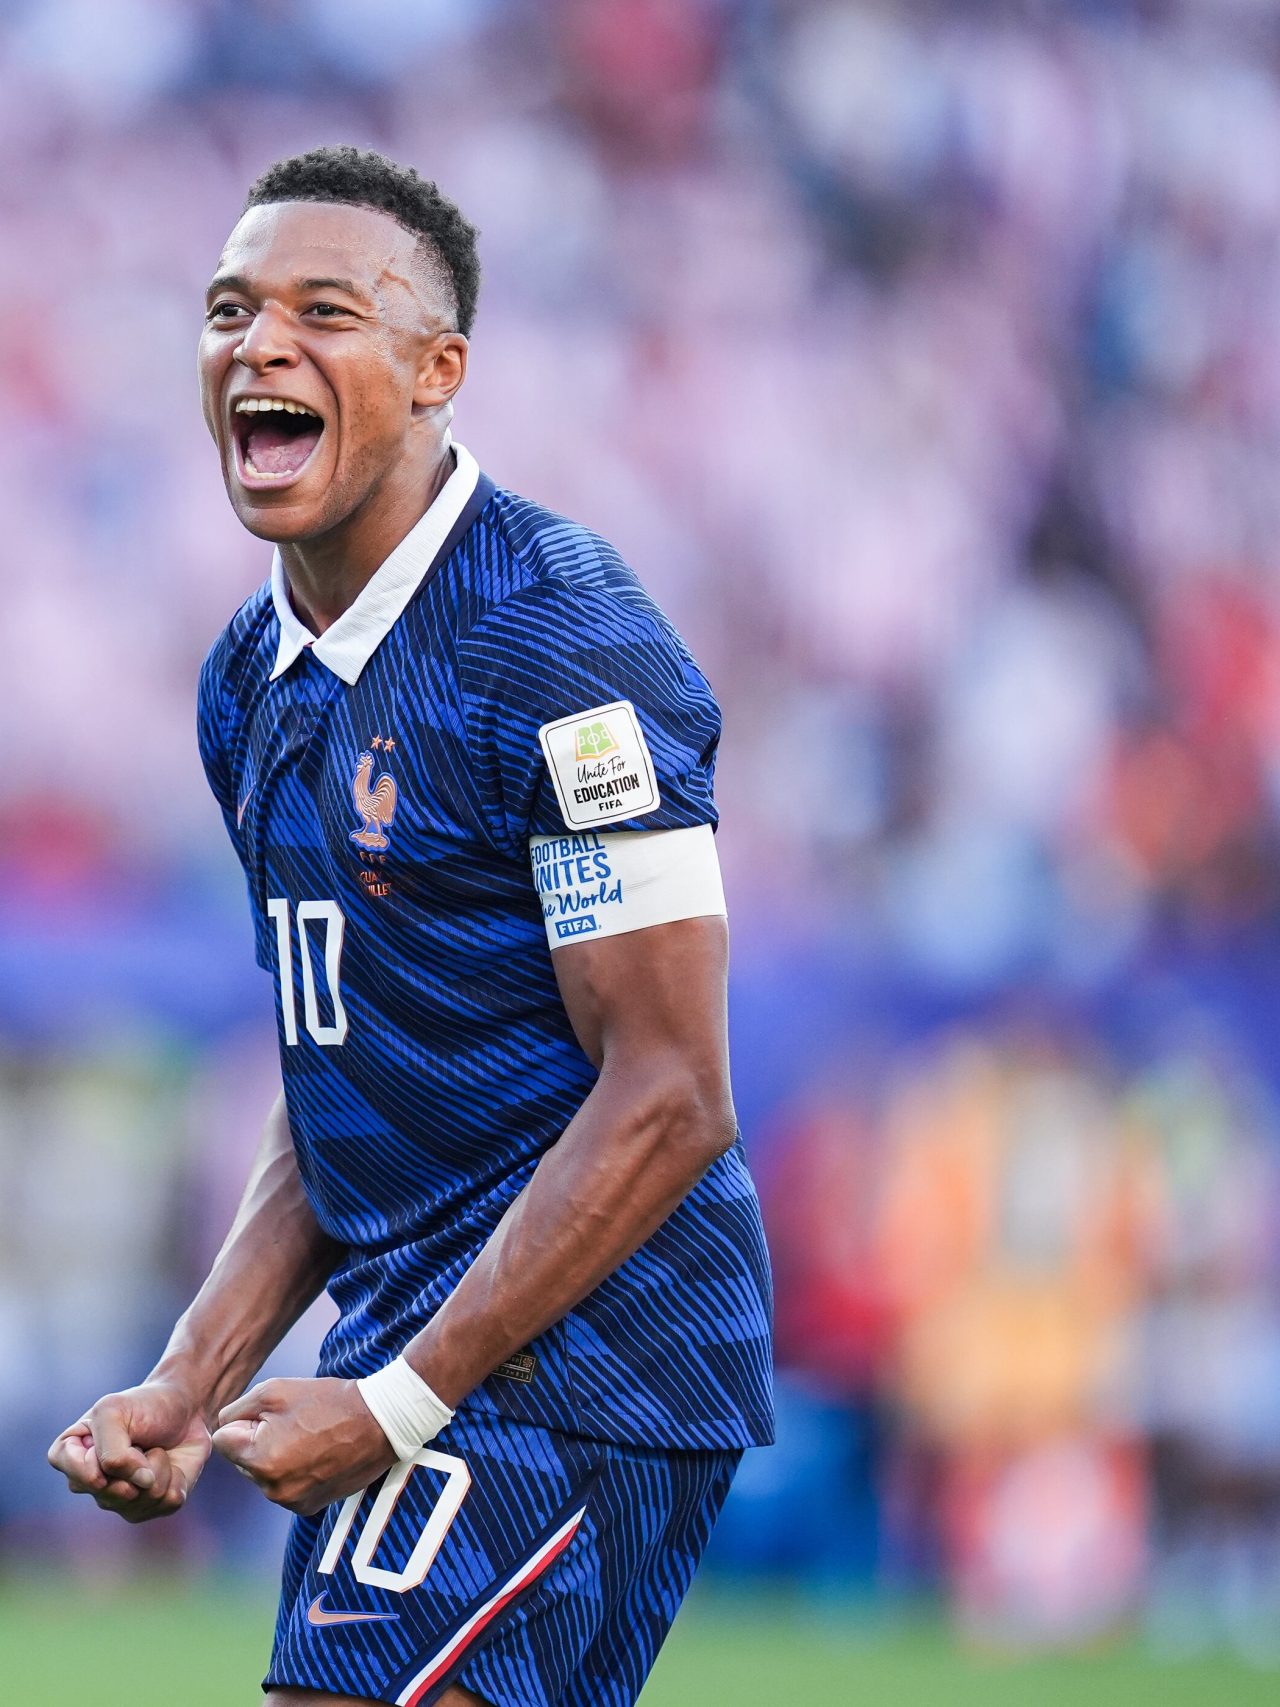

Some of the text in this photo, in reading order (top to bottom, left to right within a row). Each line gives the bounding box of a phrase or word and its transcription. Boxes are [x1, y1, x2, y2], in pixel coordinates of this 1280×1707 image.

[577, 755, 626, 783] Unite For
[574, 773, 640, 804] EDUCATION
[599, 799, 623, 811] FIFA
[556, 879, 623, 915] World
[557, 917, 595, 936] FIFA
[267, 898, 348, 1046] 10
[317, 1447, 472, 1593] 10
